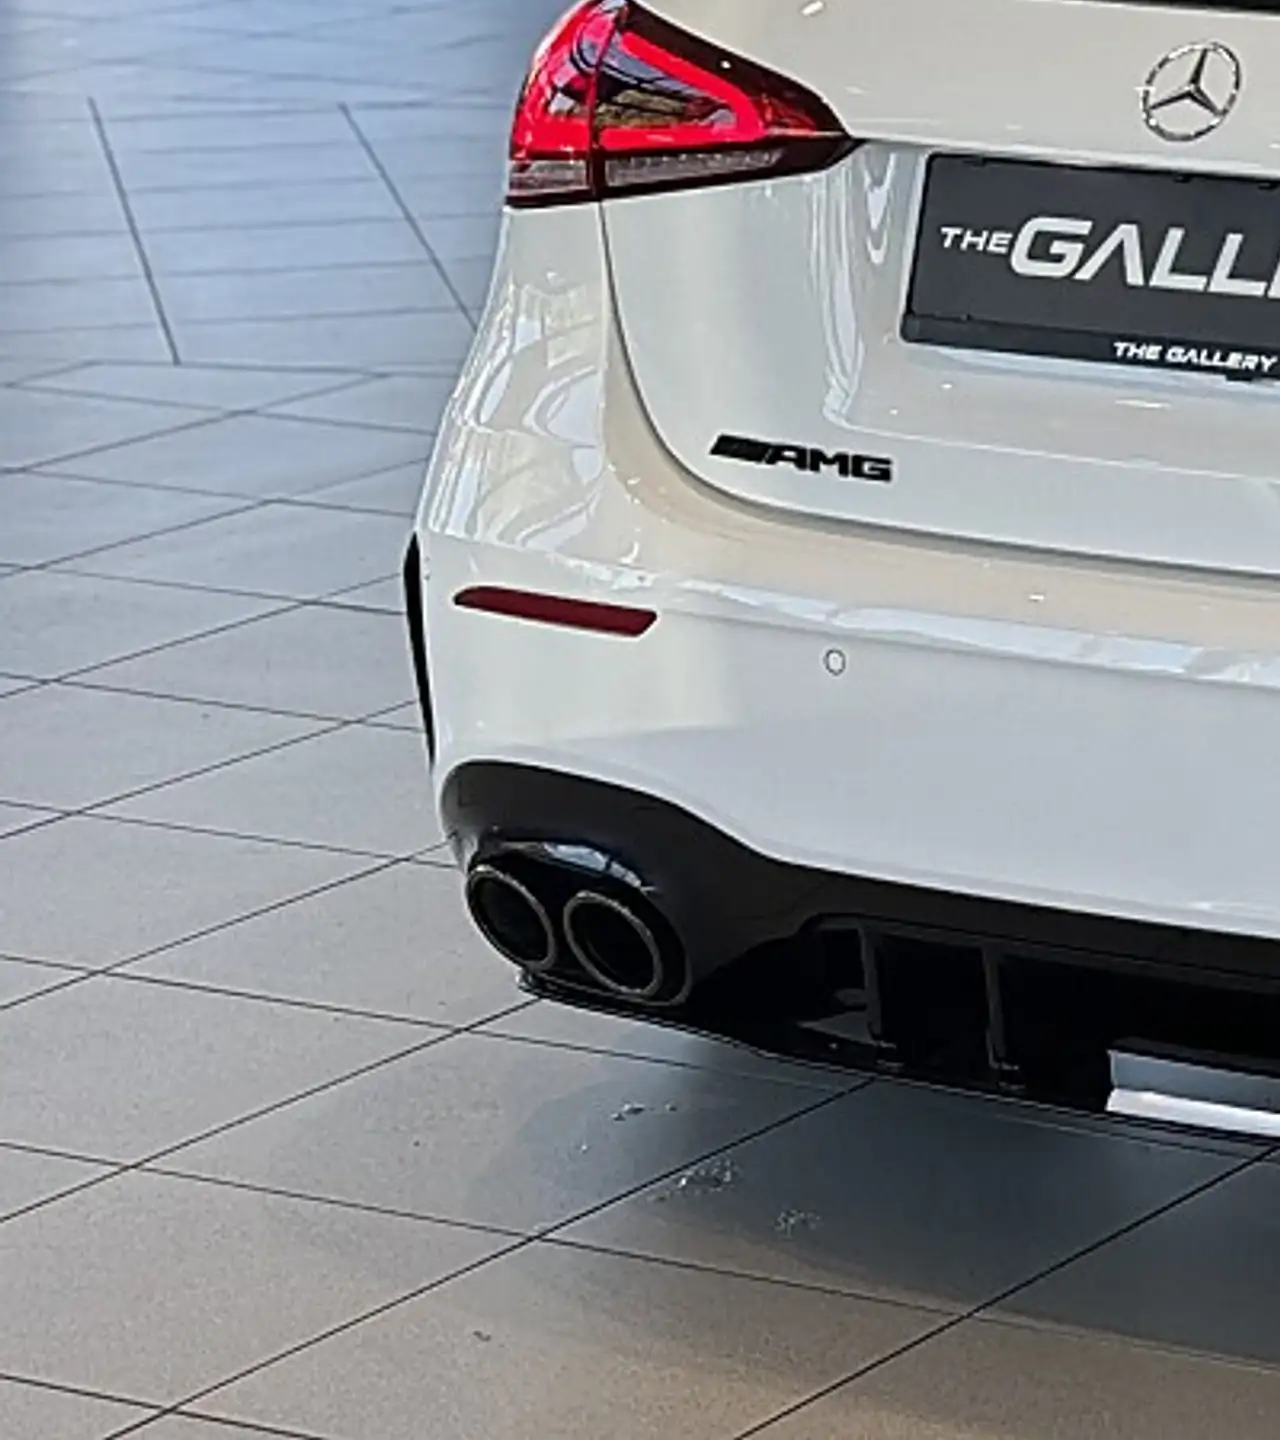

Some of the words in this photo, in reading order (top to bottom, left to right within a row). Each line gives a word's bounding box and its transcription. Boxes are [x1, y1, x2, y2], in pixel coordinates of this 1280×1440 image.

[940, 226, 1012, 254] THE
[1113, 341, 1162, 362] THE
[1166, 345, 1278, 373] GALLERY
[767, 444, 893, 482] AMG
